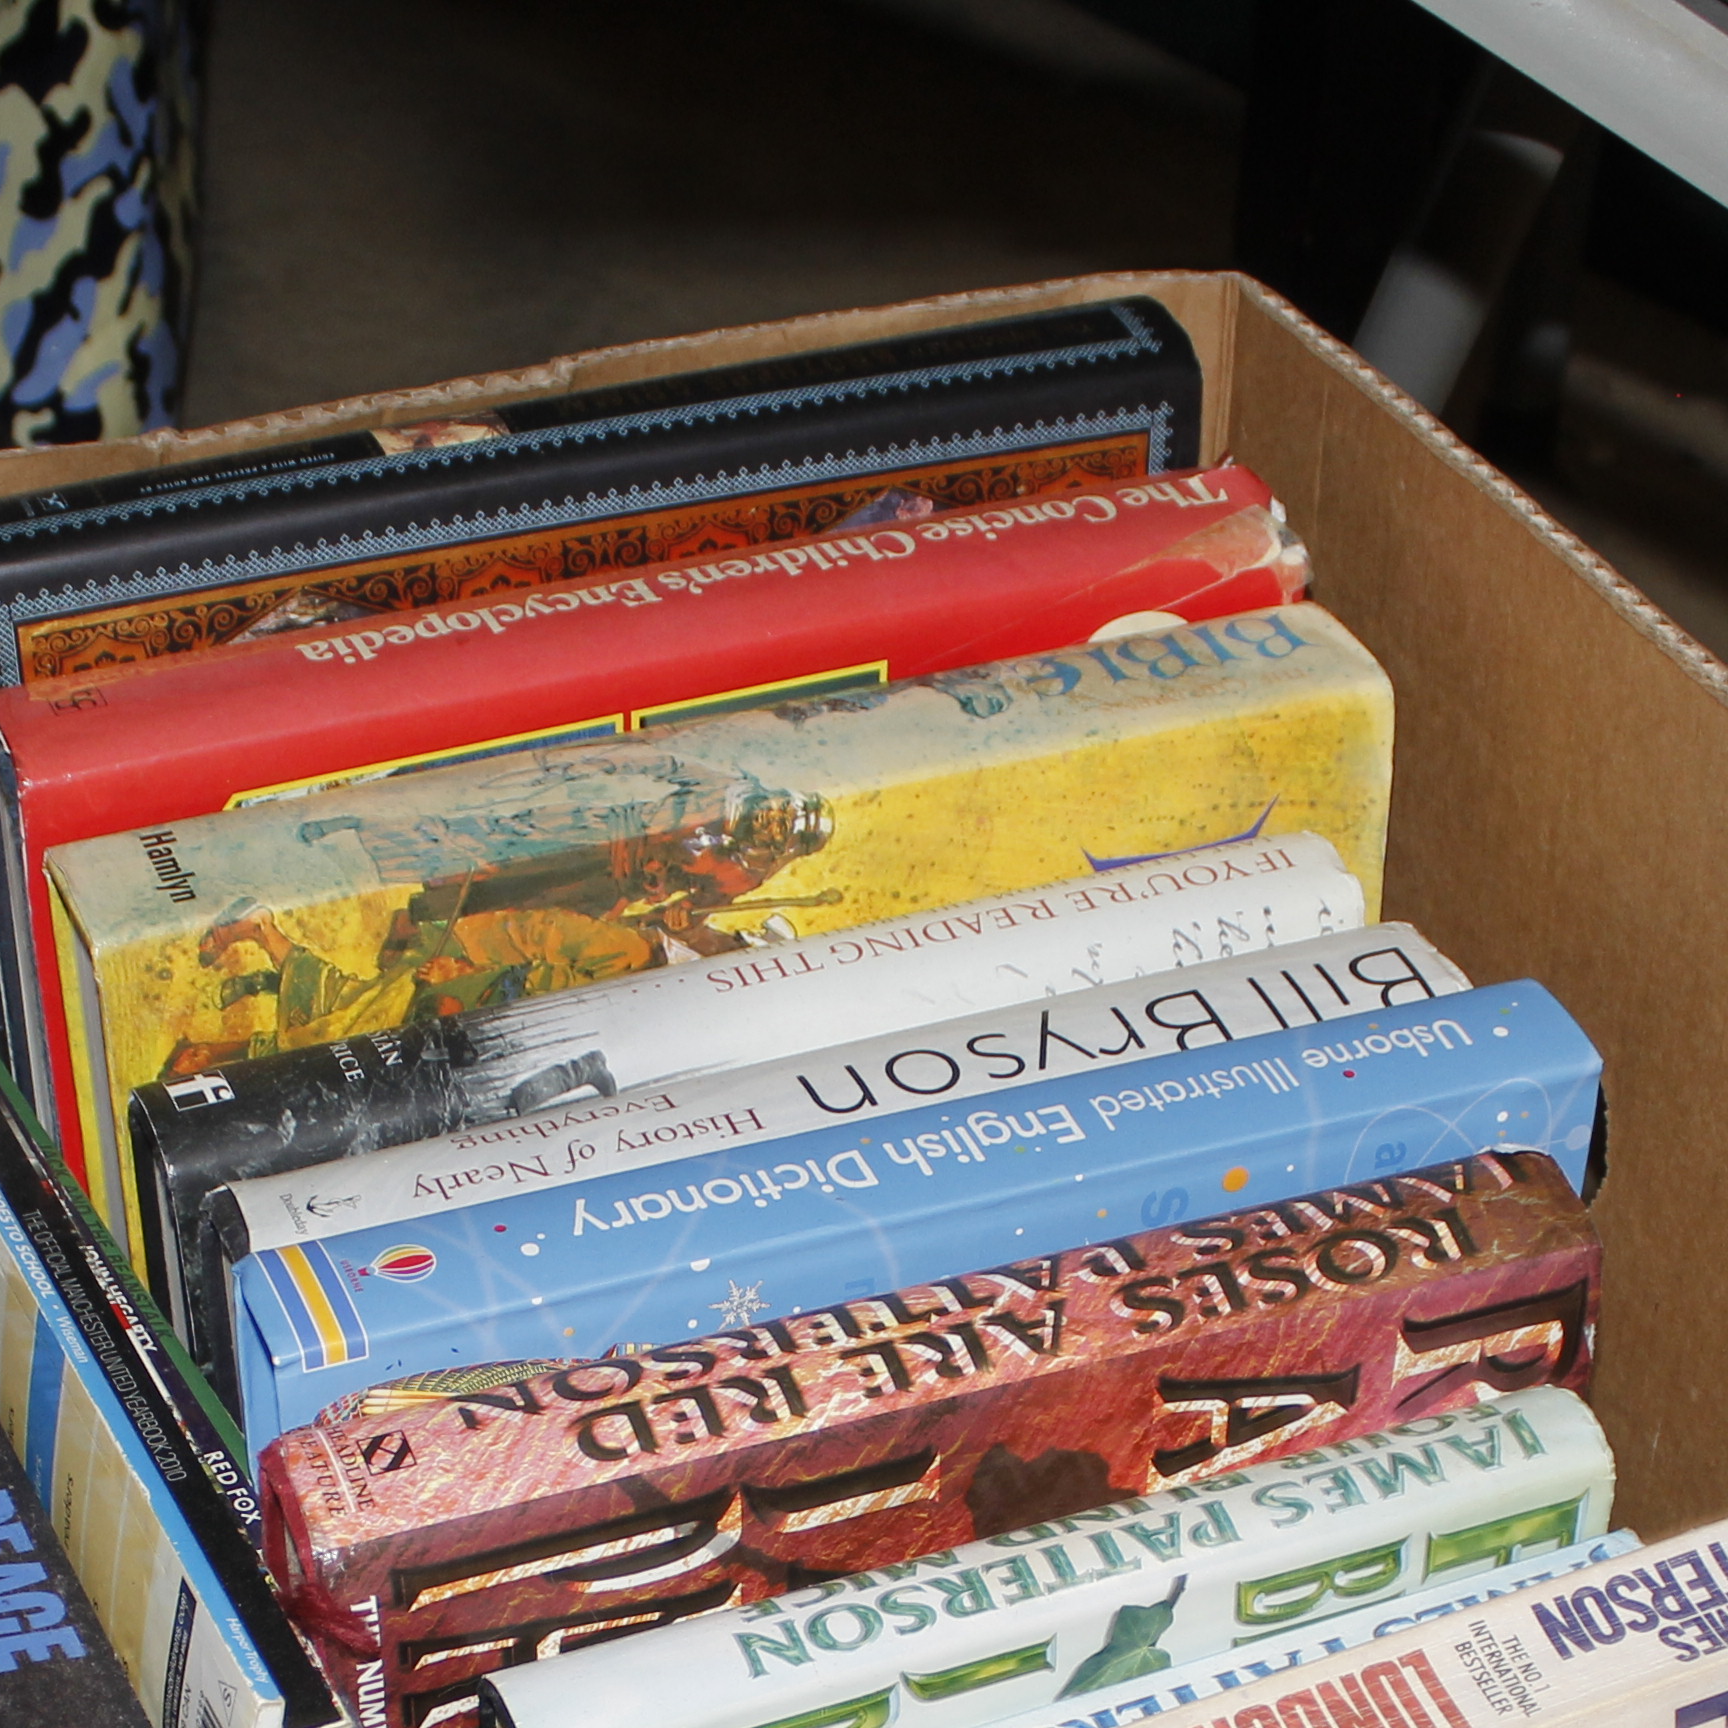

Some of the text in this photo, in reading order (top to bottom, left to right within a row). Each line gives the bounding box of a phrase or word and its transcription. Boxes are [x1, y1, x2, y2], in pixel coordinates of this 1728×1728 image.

[295, 474, 1230, 665] The Concise Children's Encyclopedia
[139, 830, 198, 904] Hamlyn
[1072, 857, 1254, 915] YOU'RE
[1255, 847, 1299, 873] IF
[829, 895, 1063, 963] READING
[705, 953, 829, 994] THIS
[327, 1038, 366, 1083] RICE
[795, 945, 1437, 1115] Bill Bryson
[412, 1107, 768, 1201] History of Nearly
[449, 1093, 681, 1151] Everything
[572, 1018, 1474, 1237] Usborne Illustrated English Dictionary
[279, 1192, 309, 1235] Doubleday
[3, 1220, 25, 1243] TO
[15, 1242, 57, 1301] SCHOOL
[54, 1315, 90, 1365] Wiseman
[89, 1219, 115, 1253] THE
[108, 1253, 173, 1339] BEANSTALK
[339, 1258, 365, 1294] USBORNE
[22, 1208, 188, 1483] THE OFFICIAL MANCHESTER UNITED YEARBOOK 2010
[571, 1206, 1478, 1464] ROSES ARE RED
[203, 1449, 263, 1527] RED FOX
[299, 1435, 348, 1519] FEATURE
[327, 1425, 377, 1513] HEADLINE
[1250, 1406, 1549, 1529] JAMES
[732, 1500, 1245, 1680] PATTERSON
[226, 1616, 270, 1684] Harper Trophy
[1454, 1640, 1514, 1717] BESTSELLER
[1468, 1619, 1542, 1718] INTERNATIONAL
[1502, 1634, 1530, 1663] THE
[1518, 1662, 1543, 1687] NO.
